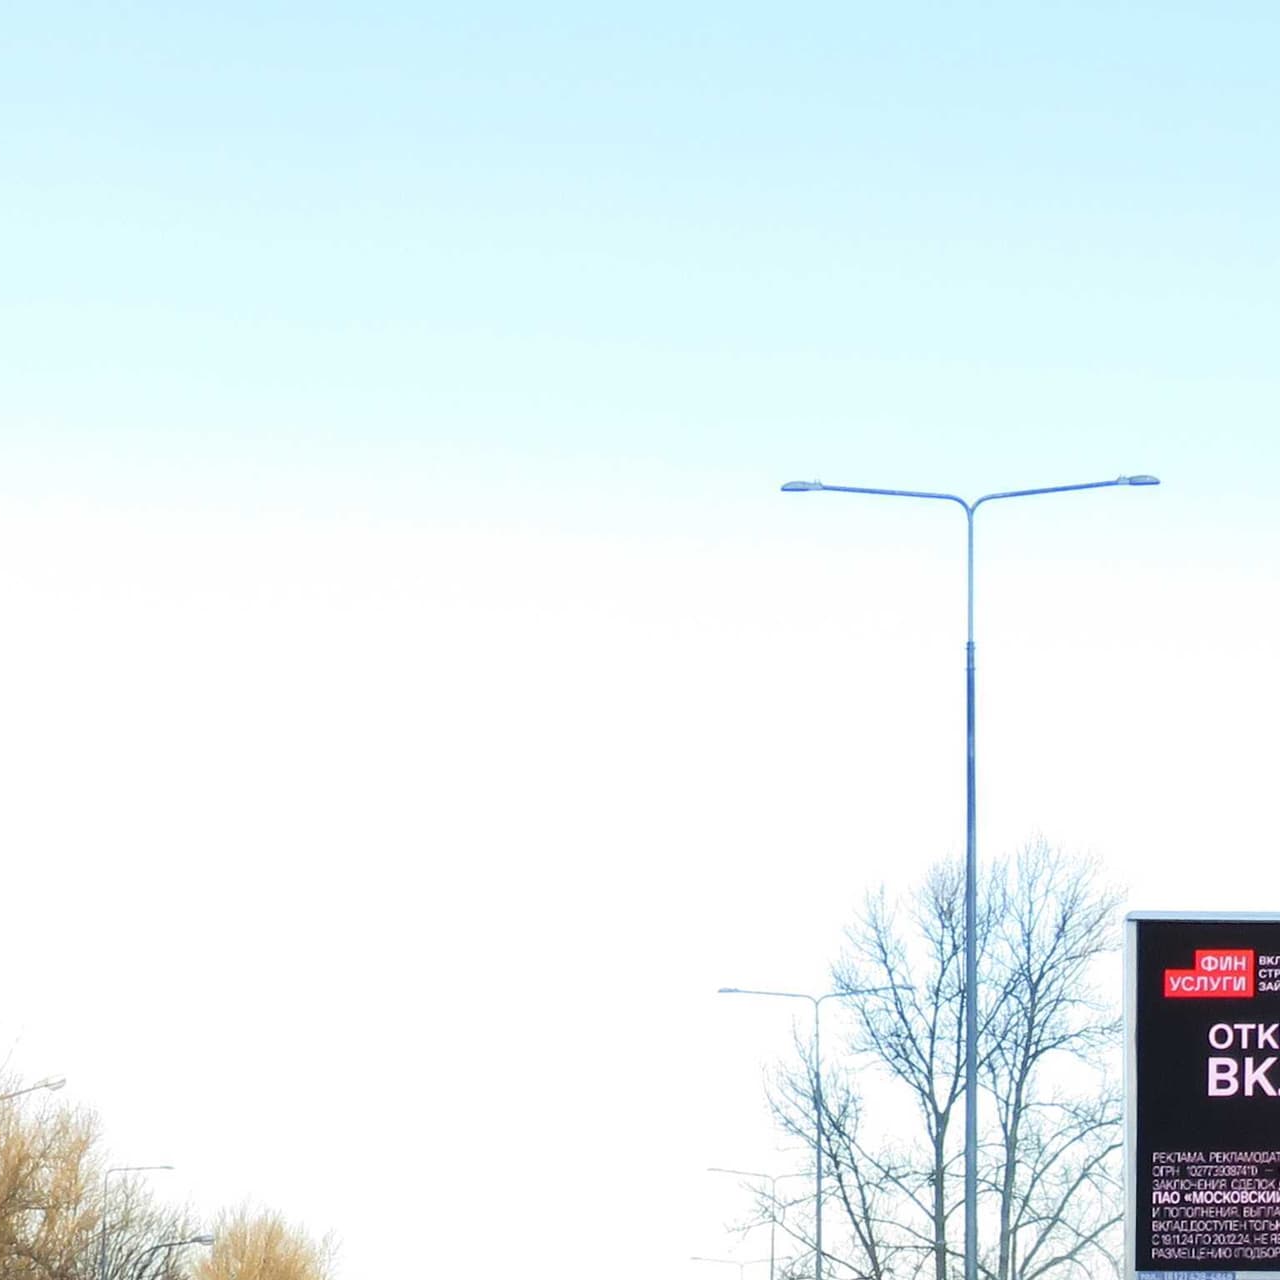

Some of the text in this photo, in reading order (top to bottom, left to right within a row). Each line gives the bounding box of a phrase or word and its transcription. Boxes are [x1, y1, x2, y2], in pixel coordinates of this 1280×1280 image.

[1201, 956, 1247, 971] ФИН
[1170, 976, 1246, 991] УСЛУГИ
[1152, 1165, 1180, 1176] ОГРН
[1152, 1179, 1226, 1190] ЗАКЛЮЧЕНИЯ
[1231, 1179, 1275, 1190] СДЕЛОК
[1152, 1191, 1180, 1203] ПАО
[1152, 1207, 1160, 1217] И
[1152, 1220, 1188, 1231] ВКЛАД
[1189, 1220, 1247, 1231] ДОСТУПЕН
[1152, 1234, 1160, 1245] С
[1195, 1234, 1211, 1245] ПО
[1253, 1234, 1269, 1245] НЕ
[1152, 1248, 1232, 1259] РАЗМЕЩЕНИЮ
